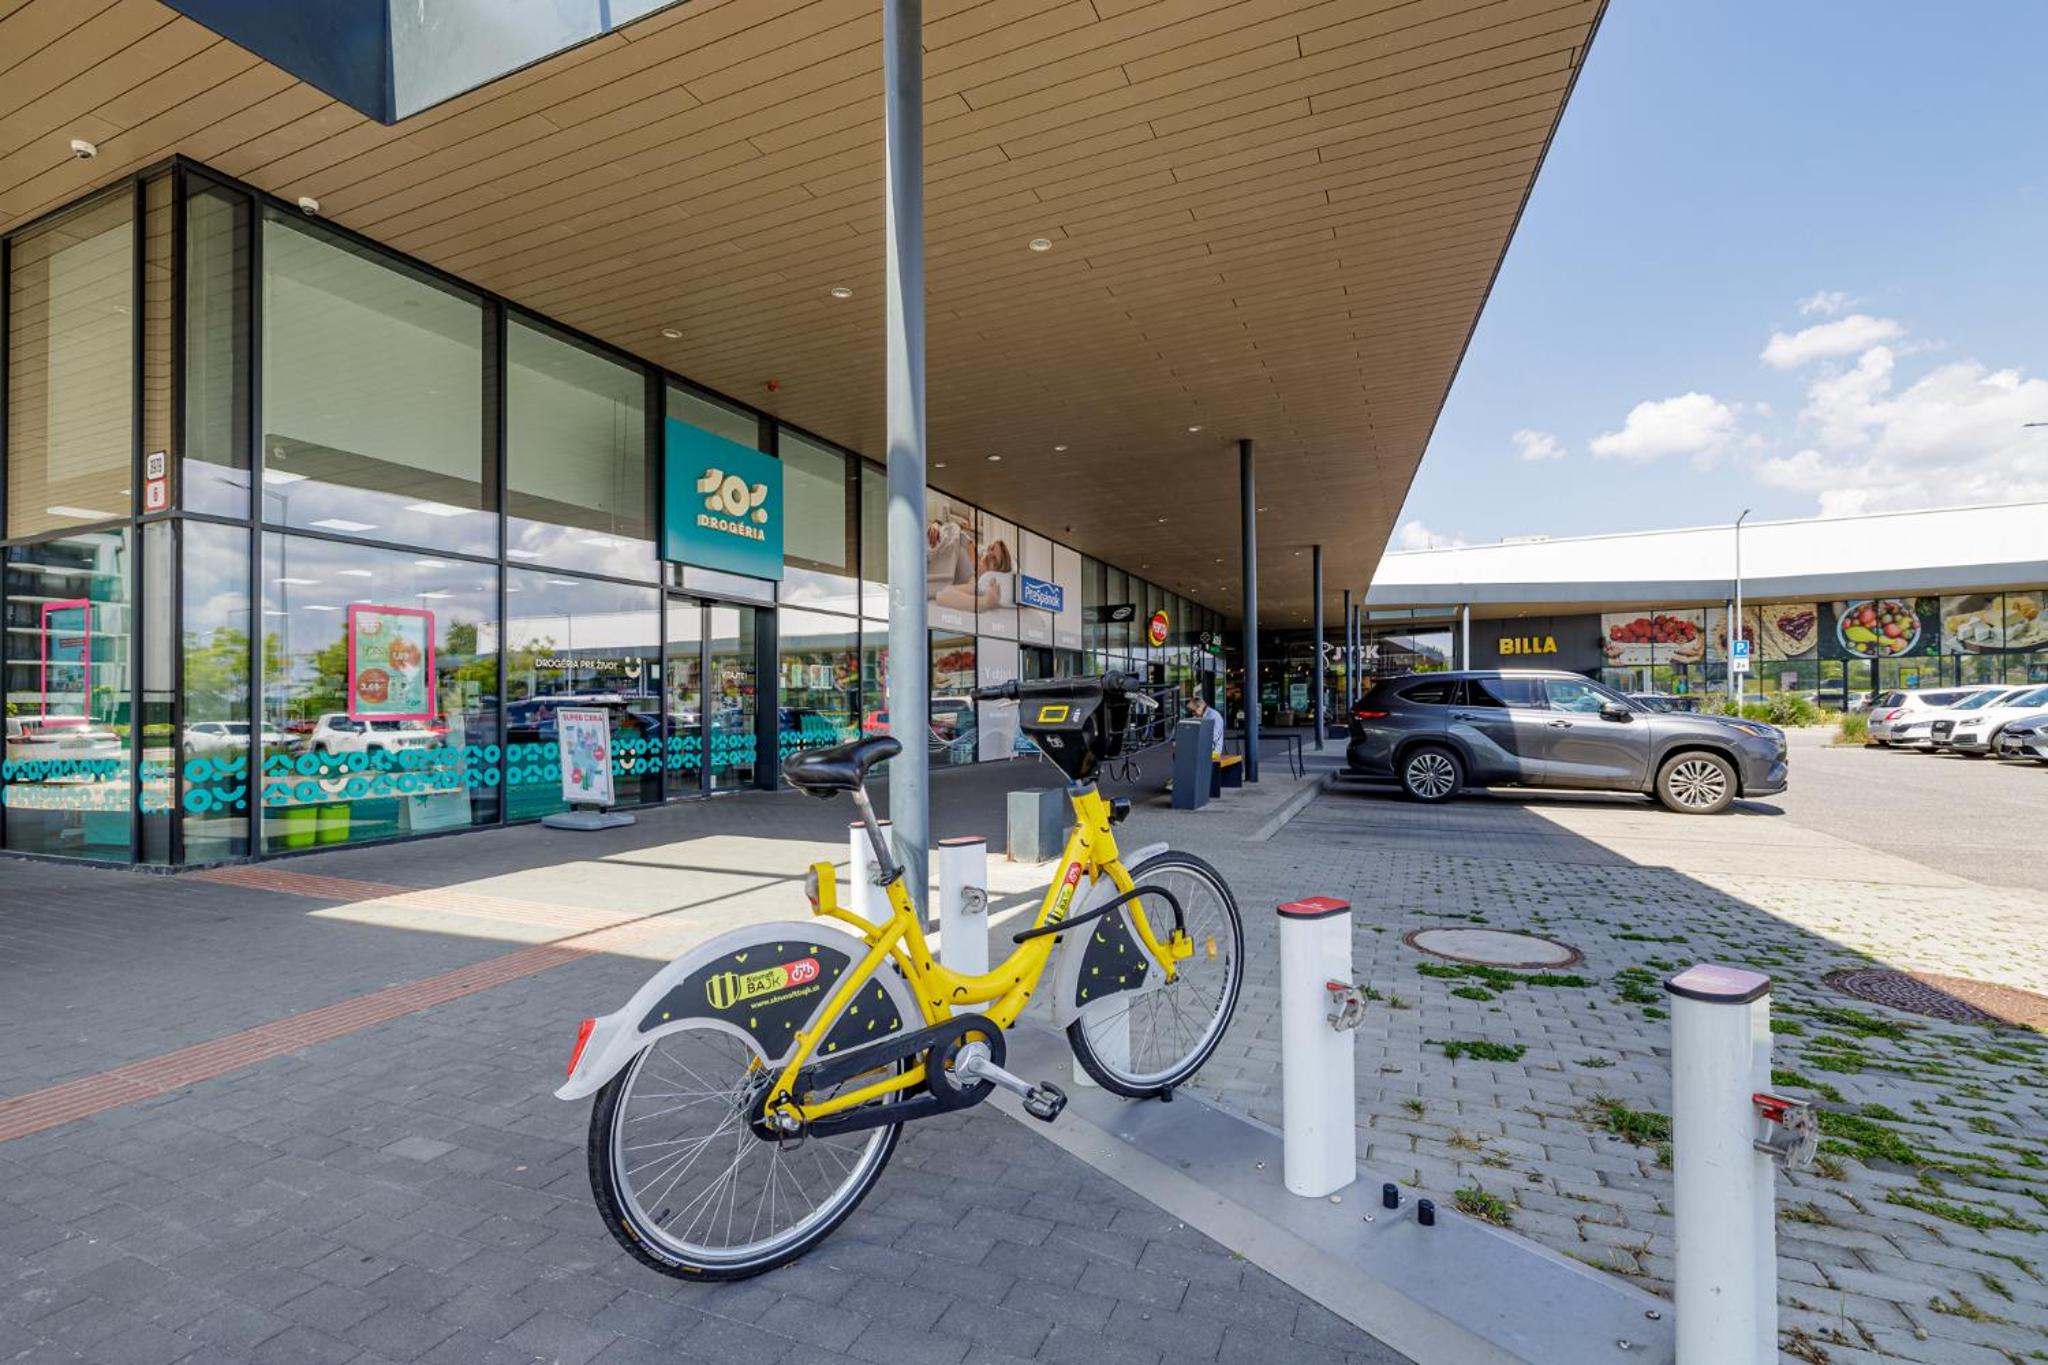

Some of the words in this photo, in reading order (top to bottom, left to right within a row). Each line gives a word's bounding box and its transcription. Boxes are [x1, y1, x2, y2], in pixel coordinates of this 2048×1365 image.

[697, 513, 766, 541] DROGÉRIA
[1499, 636, 1557, 655] BILLA
[747, 977, 781, 994] BAJK
